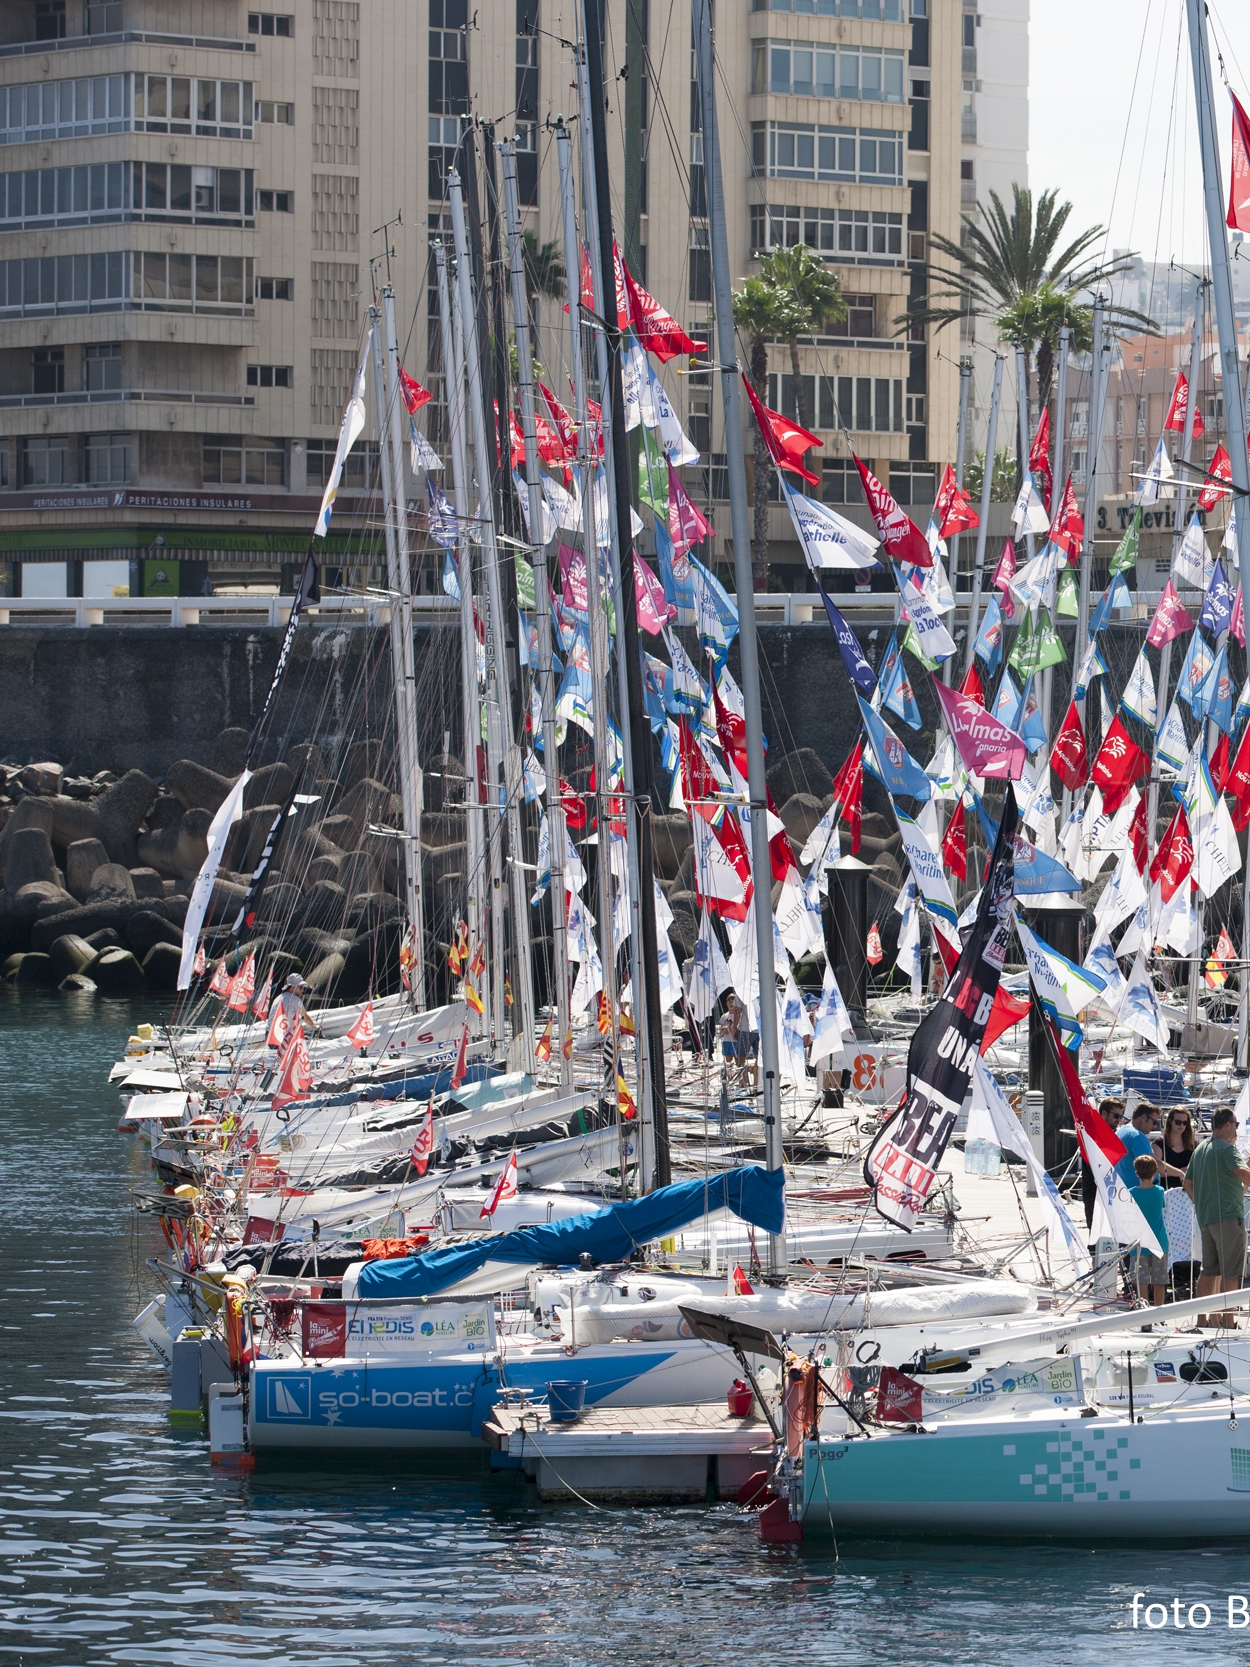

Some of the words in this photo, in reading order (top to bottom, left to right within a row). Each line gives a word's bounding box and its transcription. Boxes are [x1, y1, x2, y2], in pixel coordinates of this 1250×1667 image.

[33, 497, 75, 508] PERITACIONES
[75, 496, 109, 506] INSULARES
[128, 495, 199, 507] PERITACIONES
[200, 498, 252, 510] INSULARES
[183, 537, 258, 549] INMOBILIARIA
[309, 1320, 318, 1328] la
[435, 1319, 455, 1331] LÉA
[462, 1318, 486, 1329] Jardin
[309, 1327, 329, 1335] mini
[1047, 1370, 1073, 1380] Jardin
[887, 1380, 896, 1390] la
[318, 1387, 475, 1408] so-boat.c
[887, 1388, 906, 1396] mini
